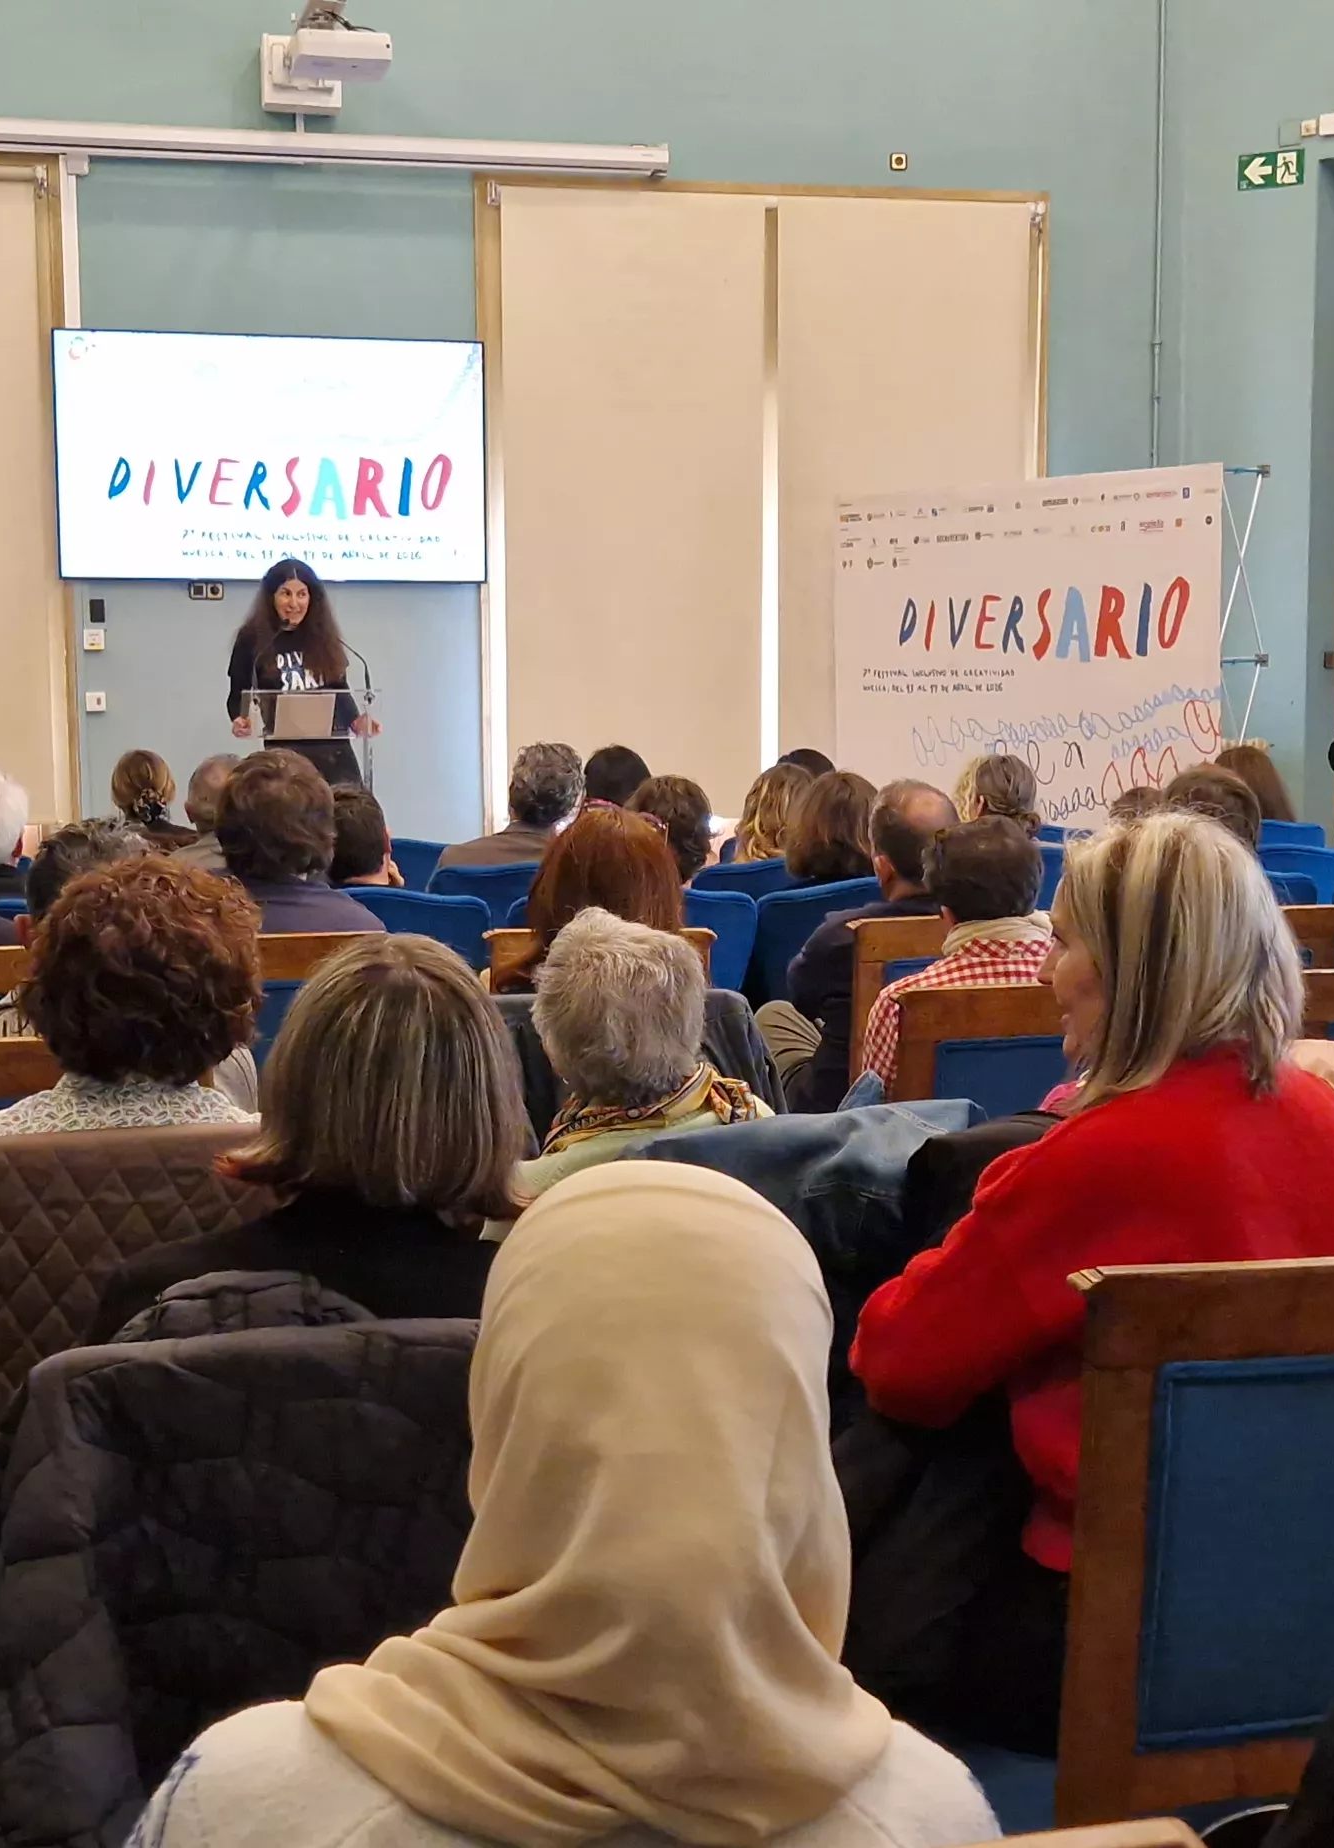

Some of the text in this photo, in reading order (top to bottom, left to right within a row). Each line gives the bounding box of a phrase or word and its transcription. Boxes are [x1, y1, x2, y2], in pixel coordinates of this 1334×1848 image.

[107, 453, 454, 521] DIVERSARIO
[898, 576, 1191, 663] DIVERSARIO
[874, 669, 908, 679] FESTIVAL
[912, 668, 947, 678] INCLUSIVO
[951, 669, 959, 678] DE
[963, 668, 1015, 678] CREATIVIDAD
[917, 683, 928, 692] AL
[941, 684, 950, 693] DE
[952, 682, 974, 692] ABRIL
